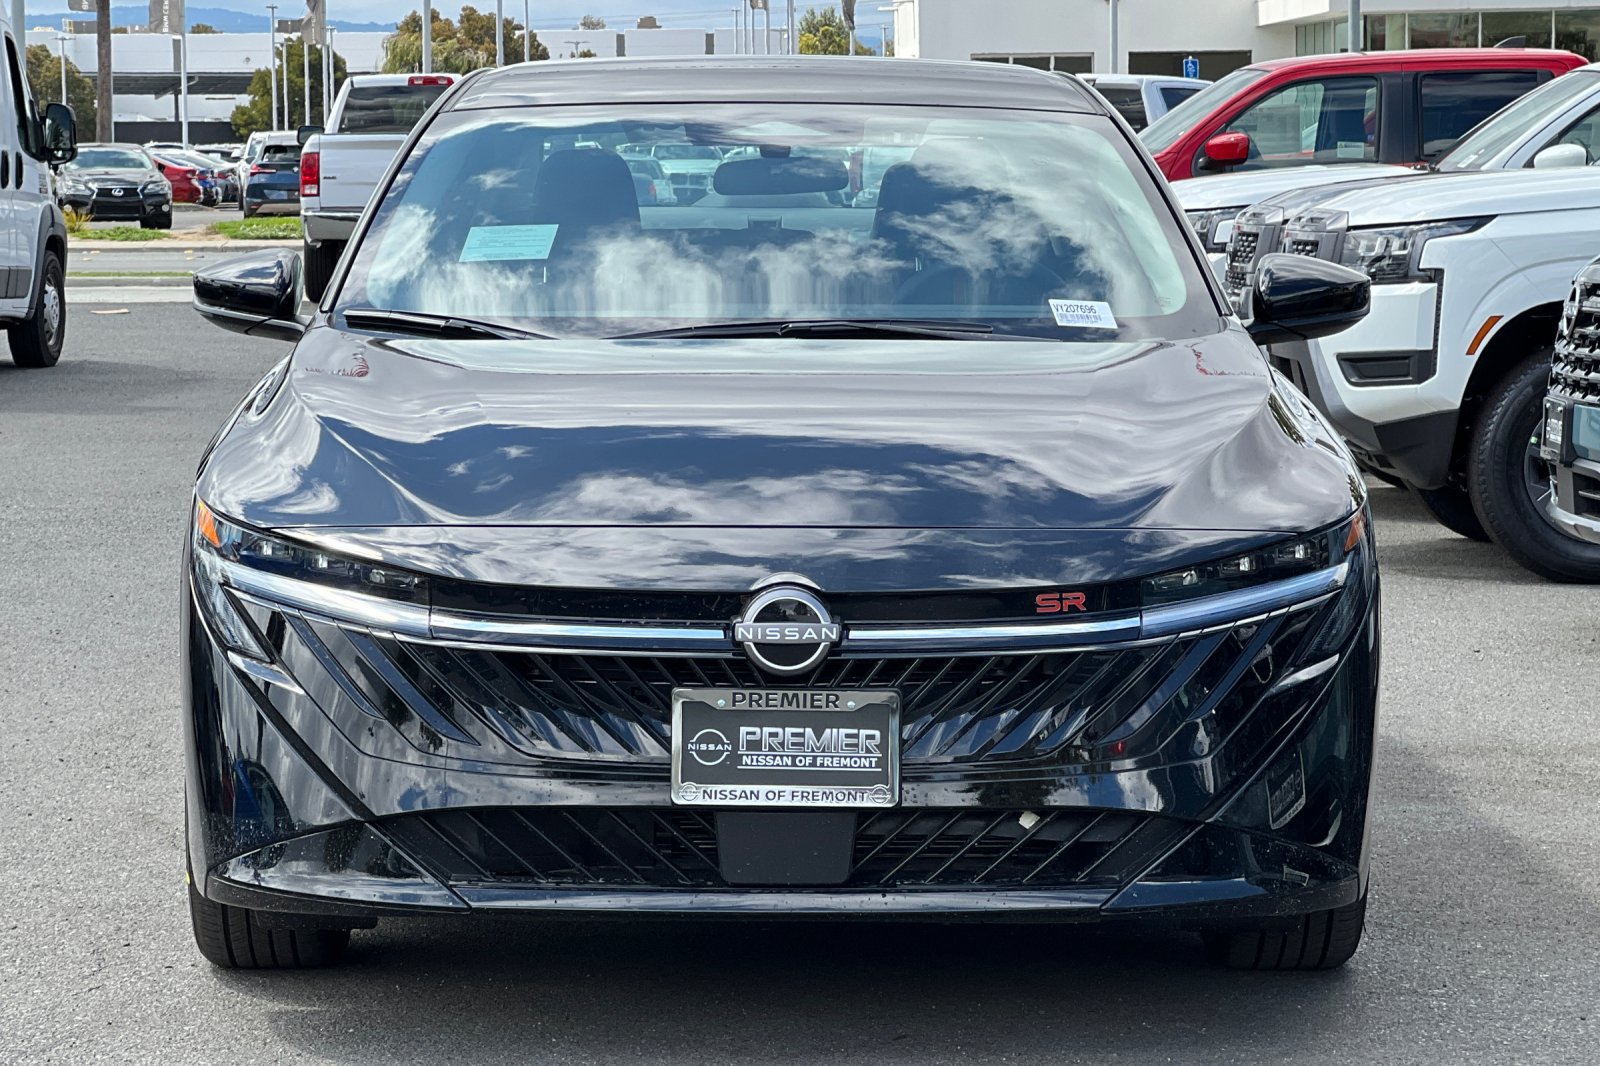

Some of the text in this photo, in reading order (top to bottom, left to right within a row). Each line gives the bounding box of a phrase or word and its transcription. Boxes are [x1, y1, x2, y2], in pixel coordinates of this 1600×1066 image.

[1052, 304, 1097, 314] VY207696
[1035, 592, 1087, 613] SR
[738, 626, 837, 640] NISSAN
[731, 692, 840, 709] PREMIER
[739, 726, 881, 754] PREMIER
[687, 743, 732, 751] NISSAN
[742, 755, 878, 768] NISSAN OF FREMONT
[702, 789, 760, 801] NISSAN
[765, 790, 786, 801] OF
[791, 790, 868, 802] FREMONT
